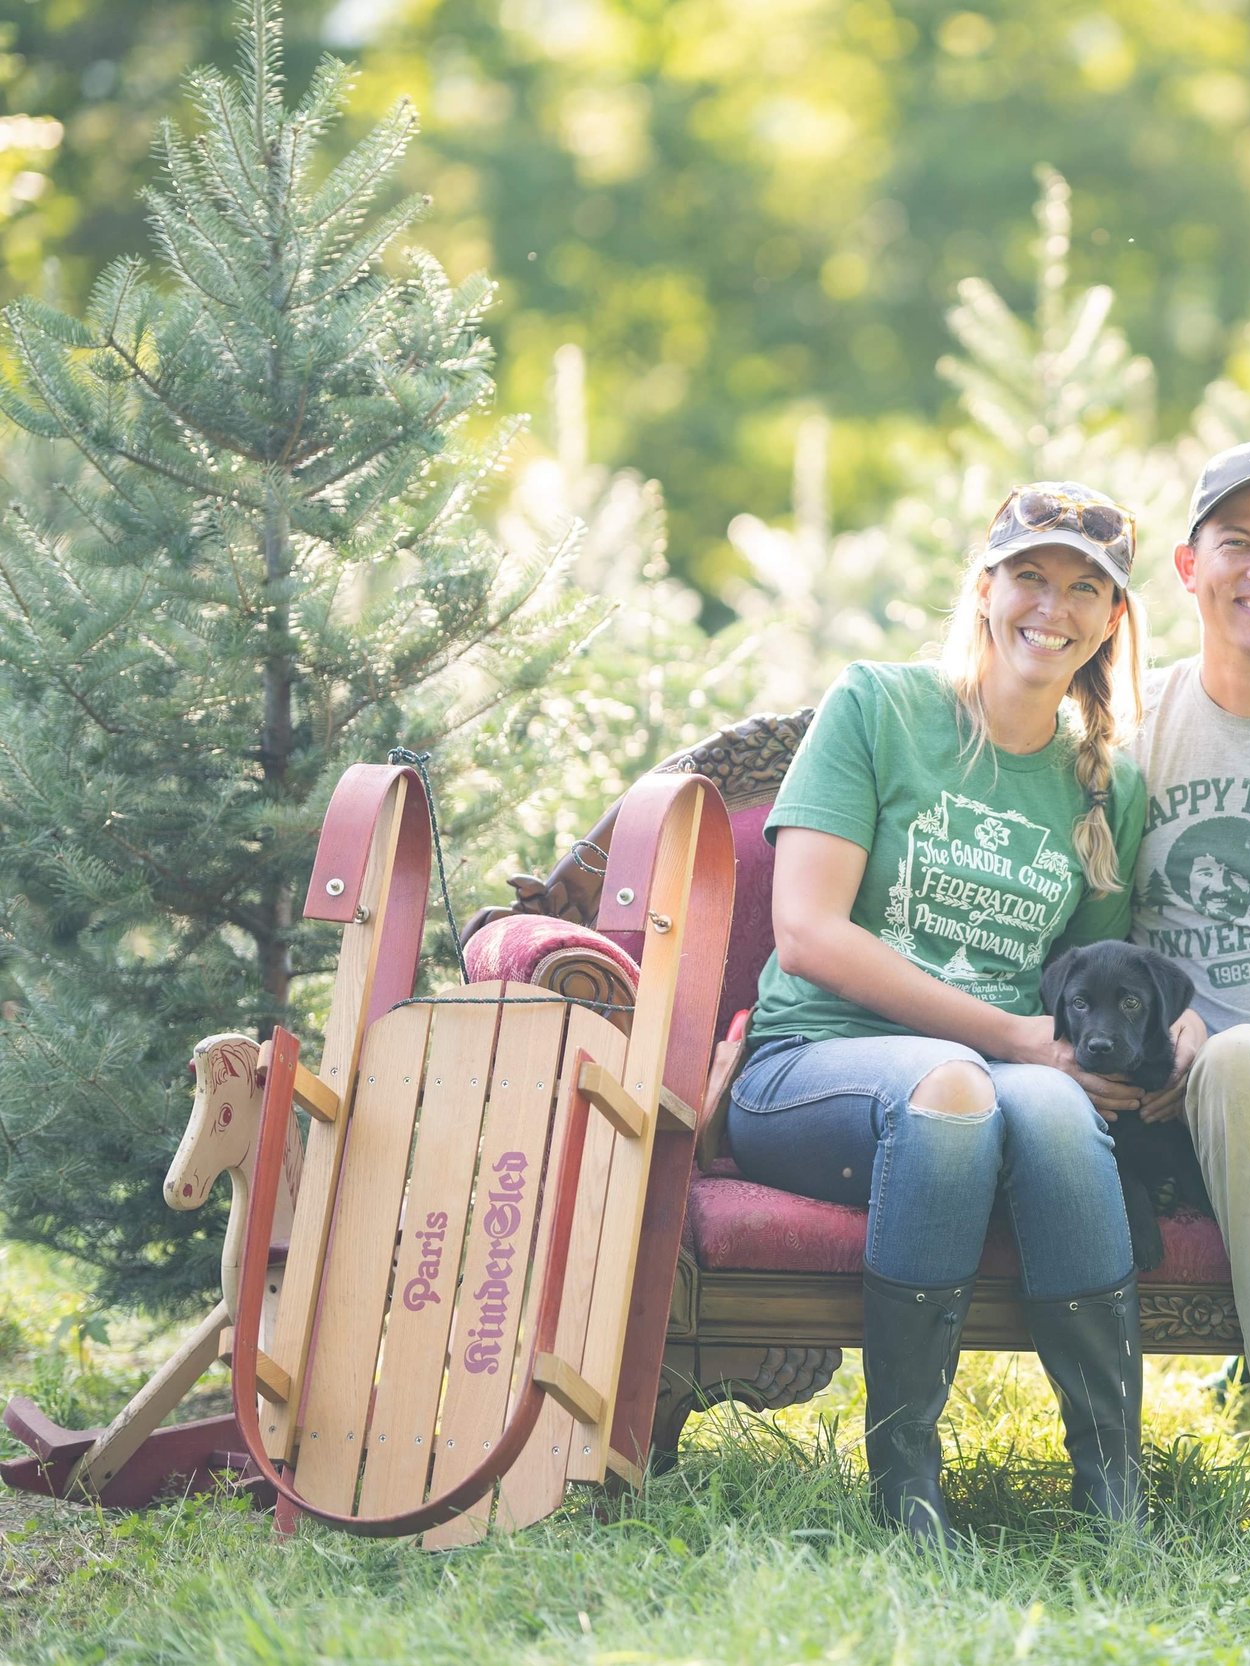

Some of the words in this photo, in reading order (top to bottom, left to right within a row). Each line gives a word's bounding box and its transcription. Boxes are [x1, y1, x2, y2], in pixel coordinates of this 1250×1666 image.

[1142, 777, 1236, 837] APPY
[915, 865, 1047, 926] FEDERATION
[917, 837, 950, 864] The
[951, 839, 1013, 880] GARDEN
[1018, 866, 1062, 902] CLUB
[913, 903, 1025, 964] PENNSYLVANIA
[968, 908, 996, 926] of
[972, 981, 998, 993] Garden
[403, 1211, 448, 1312] Paris
[463, 1151, 529, 1375] KinderSled
